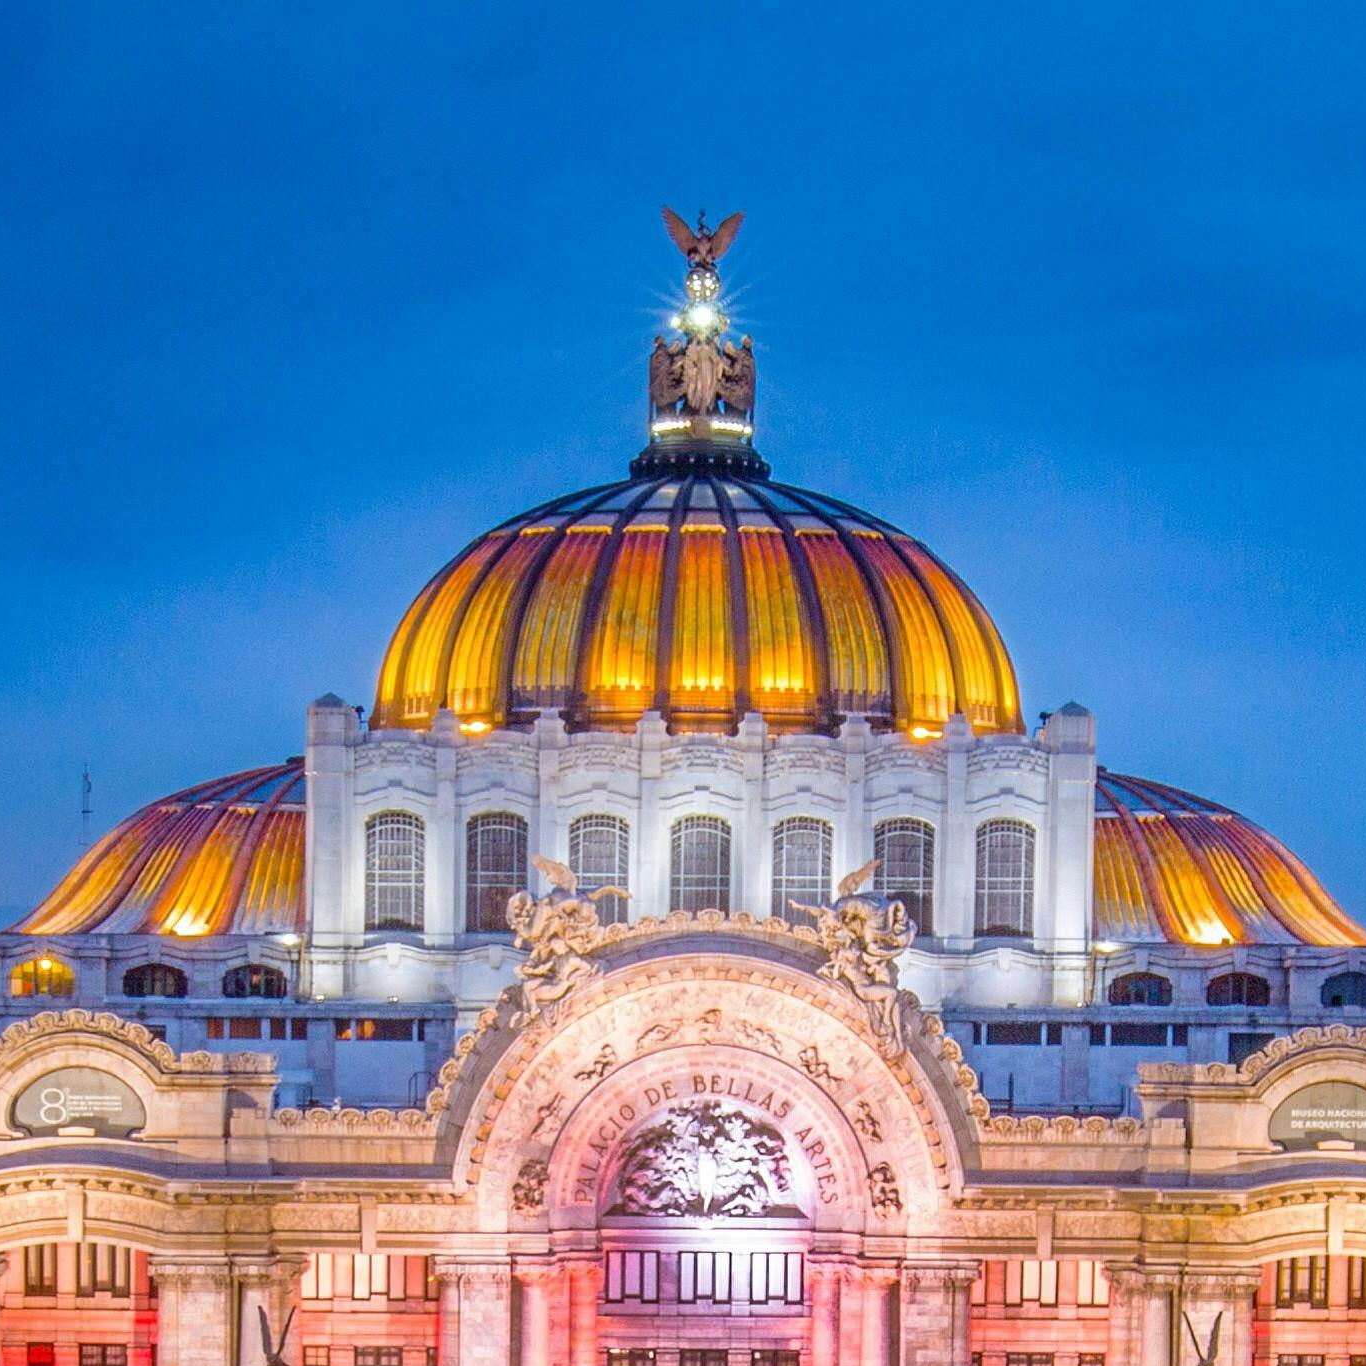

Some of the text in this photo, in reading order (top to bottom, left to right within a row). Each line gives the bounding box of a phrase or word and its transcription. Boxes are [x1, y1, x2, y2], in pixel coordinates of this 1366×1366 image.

[1291, 1109, 1326, 1117] MUSEO
[1291, 1120, 1304, 1128] DE
[574, 1073, 838, 1205] PALACIO DE BELLAS ARTES
